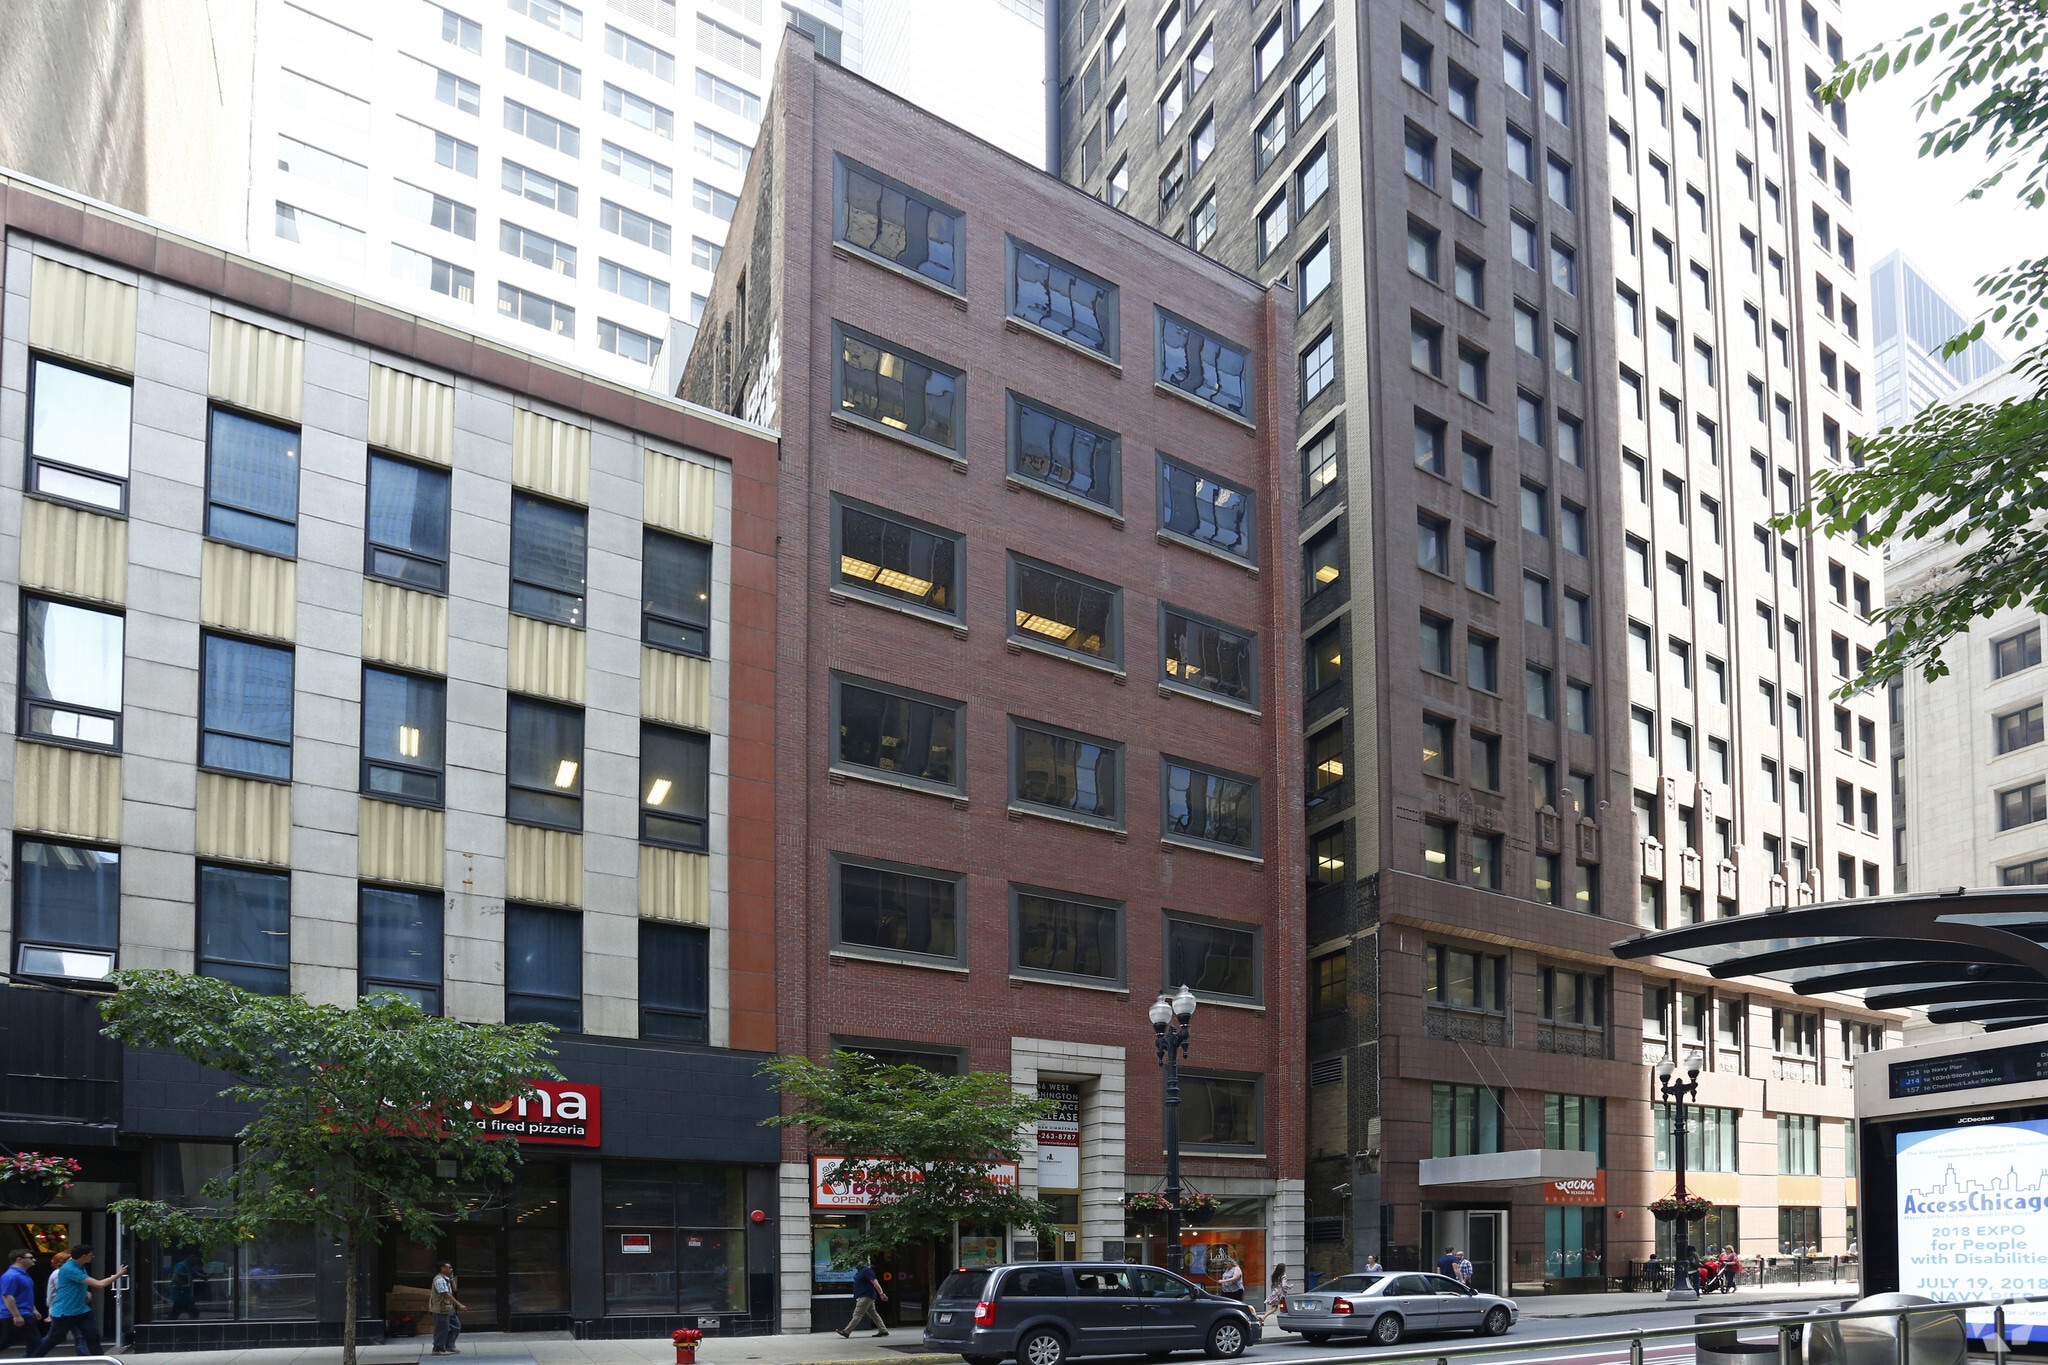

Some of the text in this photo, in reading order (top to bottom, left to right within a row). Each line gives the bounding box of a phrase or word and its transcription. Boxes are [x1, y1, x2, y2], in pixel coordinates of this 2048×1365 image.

[1932, 1066, 1948, 1074] Navy
[1047, 1112, 1078, 1121] LEASE
[1957, 1115, 1995, 1124] JCDecaux
[491, 1119, 525, 1132] fired
[529, 1122, 585, 1135] pizzeria
[831, 1196, 865, 1204] OPEN
[1931, 1225, 2026, 1238] 2018 EXPO
[1931, 1238, 2027, 1253] for People
[1911, 1253, 1949, 1265] with
[1916, 1277, 2048, 1291] JULY 19, 2018
[1930, 1291, 1984, 1302] NAVY
